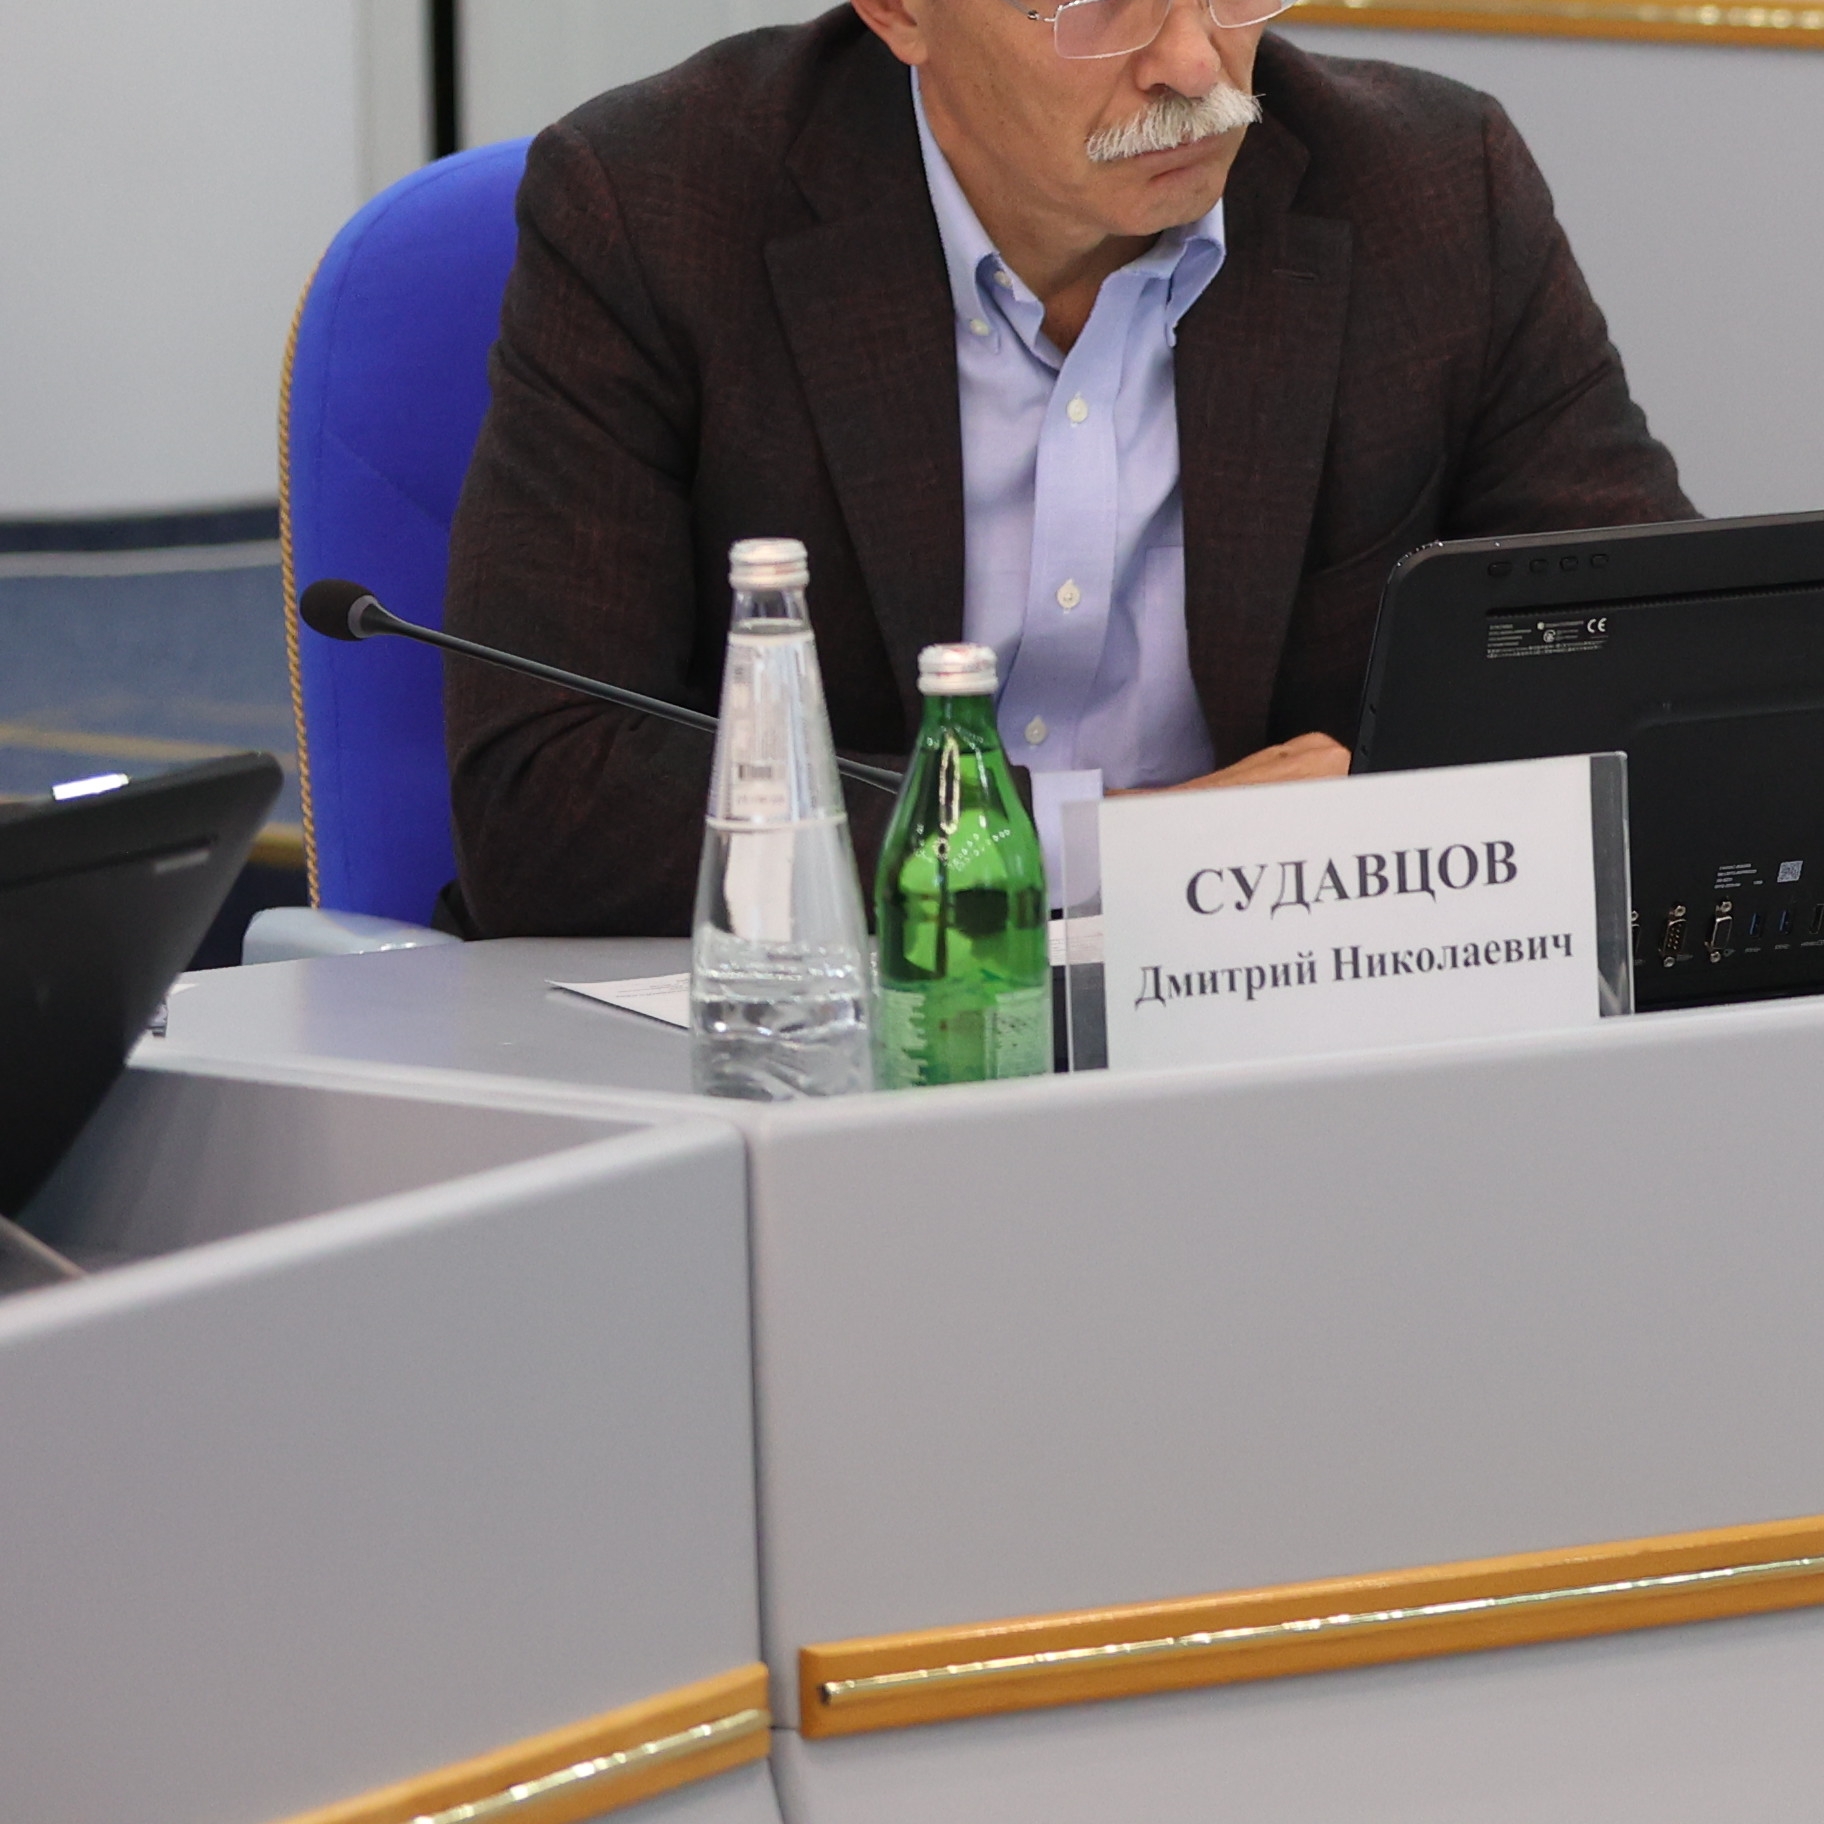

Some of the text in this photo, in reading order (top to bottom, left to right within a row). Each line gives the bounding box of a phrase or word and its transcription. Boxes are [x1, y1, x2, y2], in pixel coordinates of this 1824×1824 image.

[1185, 839, 1519, 917] СУДАВЦОВ
[1134, 949, 1318, 1008] Дмитрий
[1332, 932, 1574, 982] Николаевич
